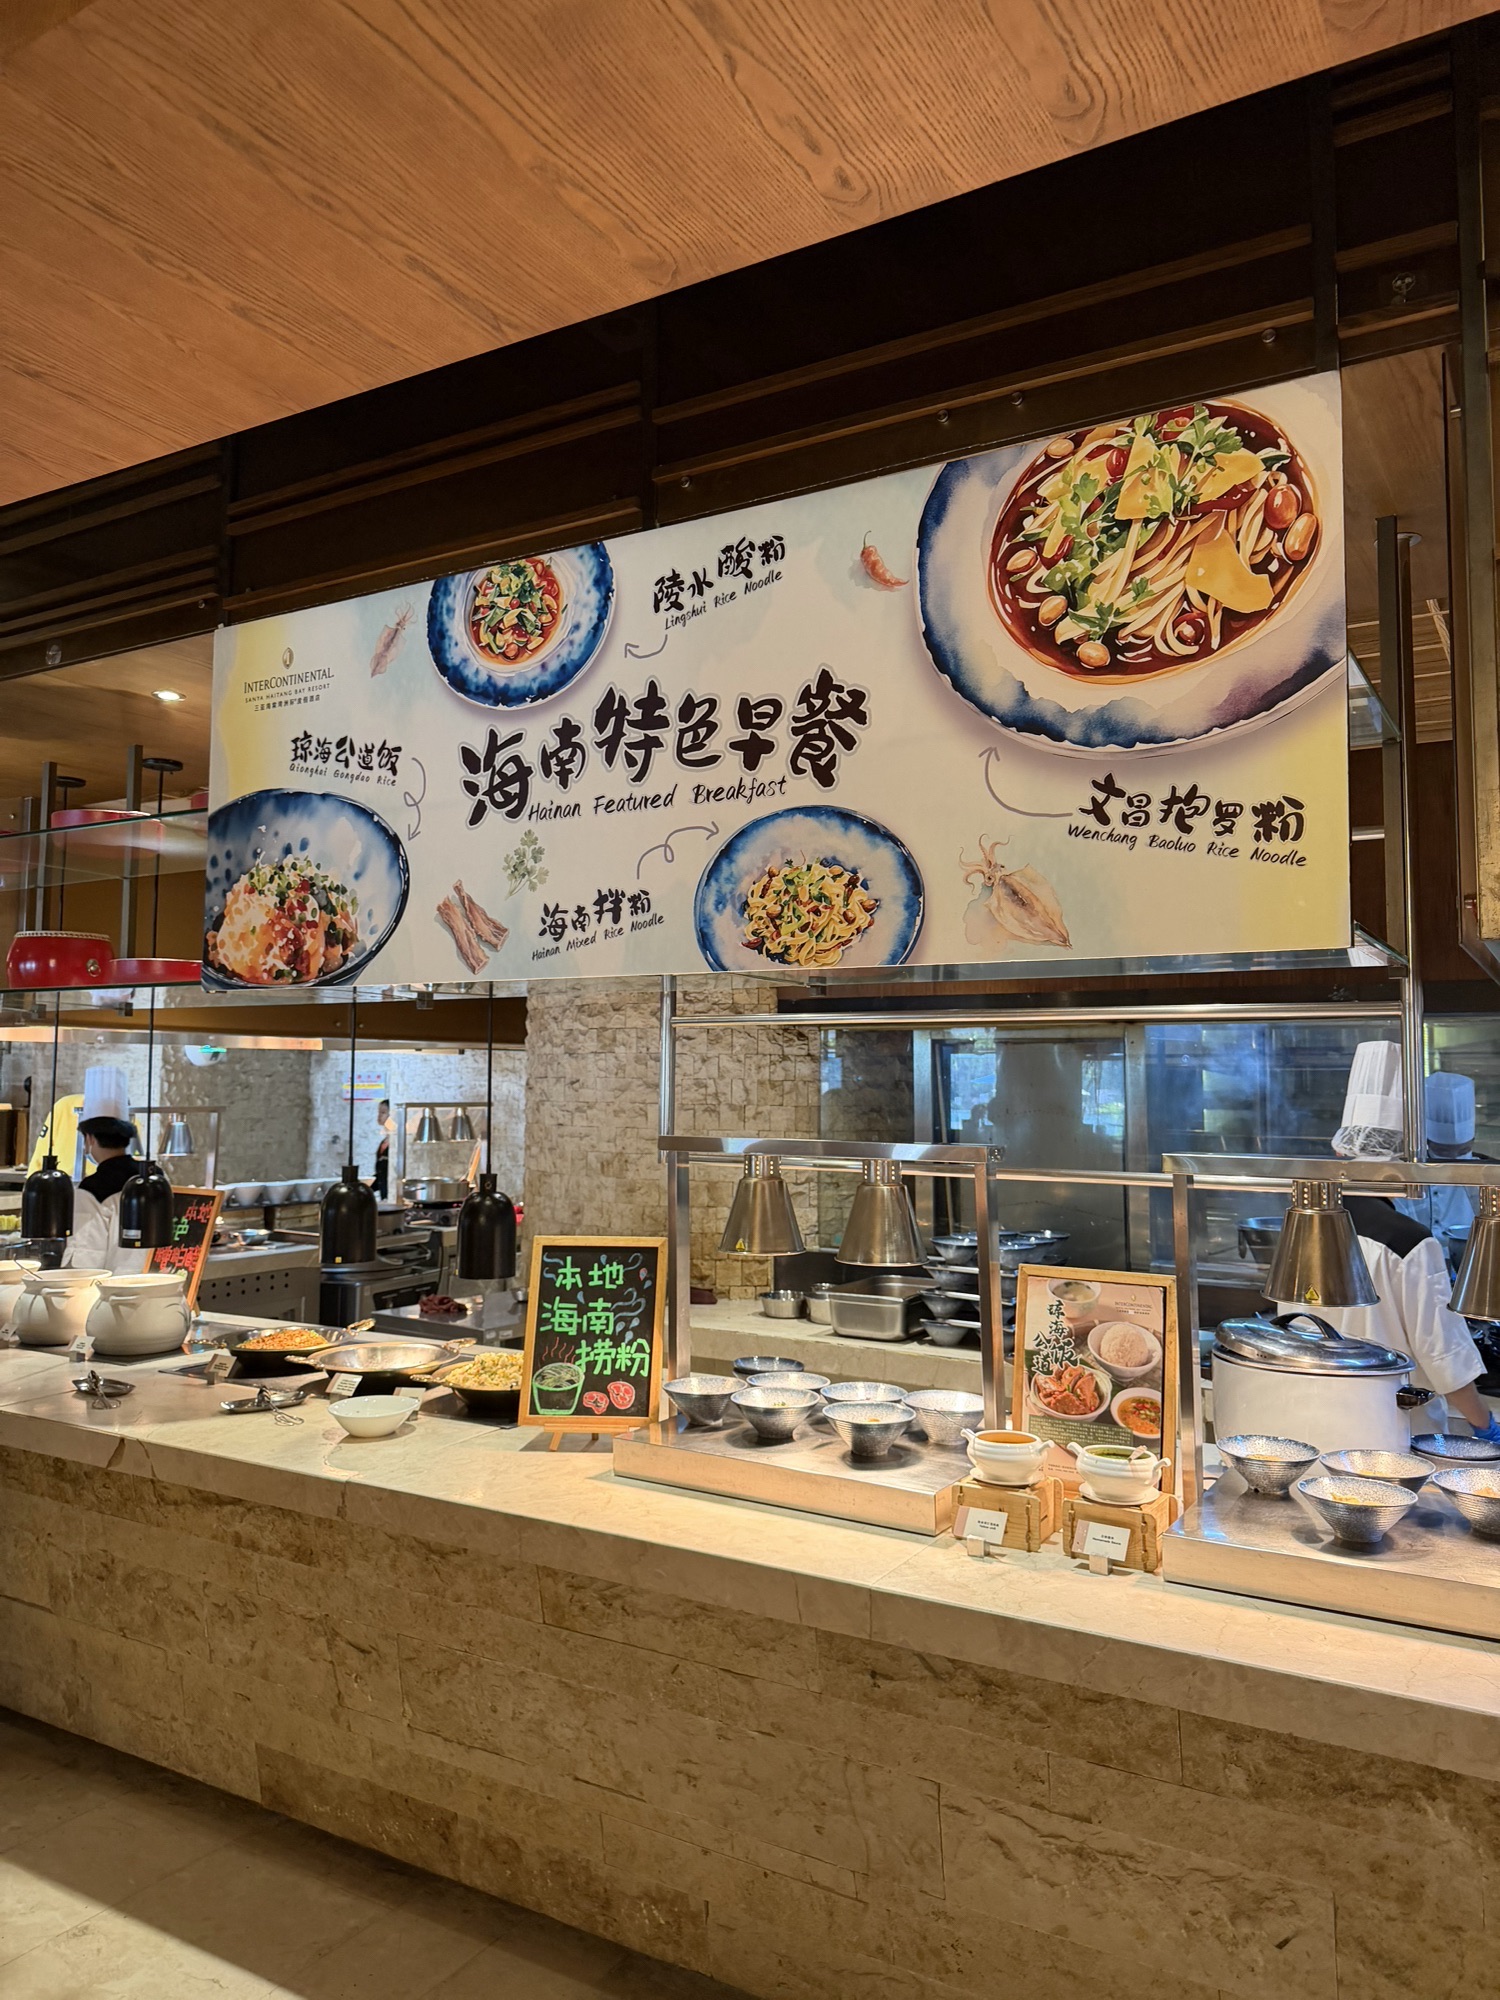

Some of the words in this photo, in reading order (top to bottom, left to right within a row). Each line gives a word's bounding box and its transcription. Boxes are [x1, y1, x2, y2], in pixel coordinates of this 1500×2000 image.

[653, 536, 786, 614] 陵水酸粉
[665, 601, 707, 630] Lingshui
[714, 591, 737, 608] Rice
[744, 569, 783, 595] Noodle
[244, 667, 335, 694] INTERCONTINENTAL
[266, 690, 293, 700] HAITANG
[295, 687, 306, 695] BAY
[308, 683, 331, 692] RESORT
[290, 729, 402, 777] 琼海公道饭
[460, 668, 869, 826] 海南特色早餐
[289, 763, 328, 778] Qionghai
[333, 769, 371, 784] Gongdao
[377, 775, 397, 787] Rice
[528, 800, 582, 822] Hainan
[593, 783, 679, 815] Featured
[692, 775, 788, 806] Breakfast
[1079, 773, 1306, 844] 文昌抱罗粉
[1067, 823, 1138, 851] Wenchang
[1149, 834, 1197, 853] Baoluo
[1207, 841, 1240, 859] Rice
[1250, 846, 1307, 868] Noodle
[532, 946, 561, 961] Hainan
[566, 930, 597, 951] Mixed
[604, 926, 625, 941] Rice
[630, 912, 665, 933] Noodle
[538, 888, 652, 943] 海南拌粉
[555, 1255, 625, 1291] 本地
[539, 1296, 615, 1336] 海南
[575, 1337, 651, 1378] 捞粉
